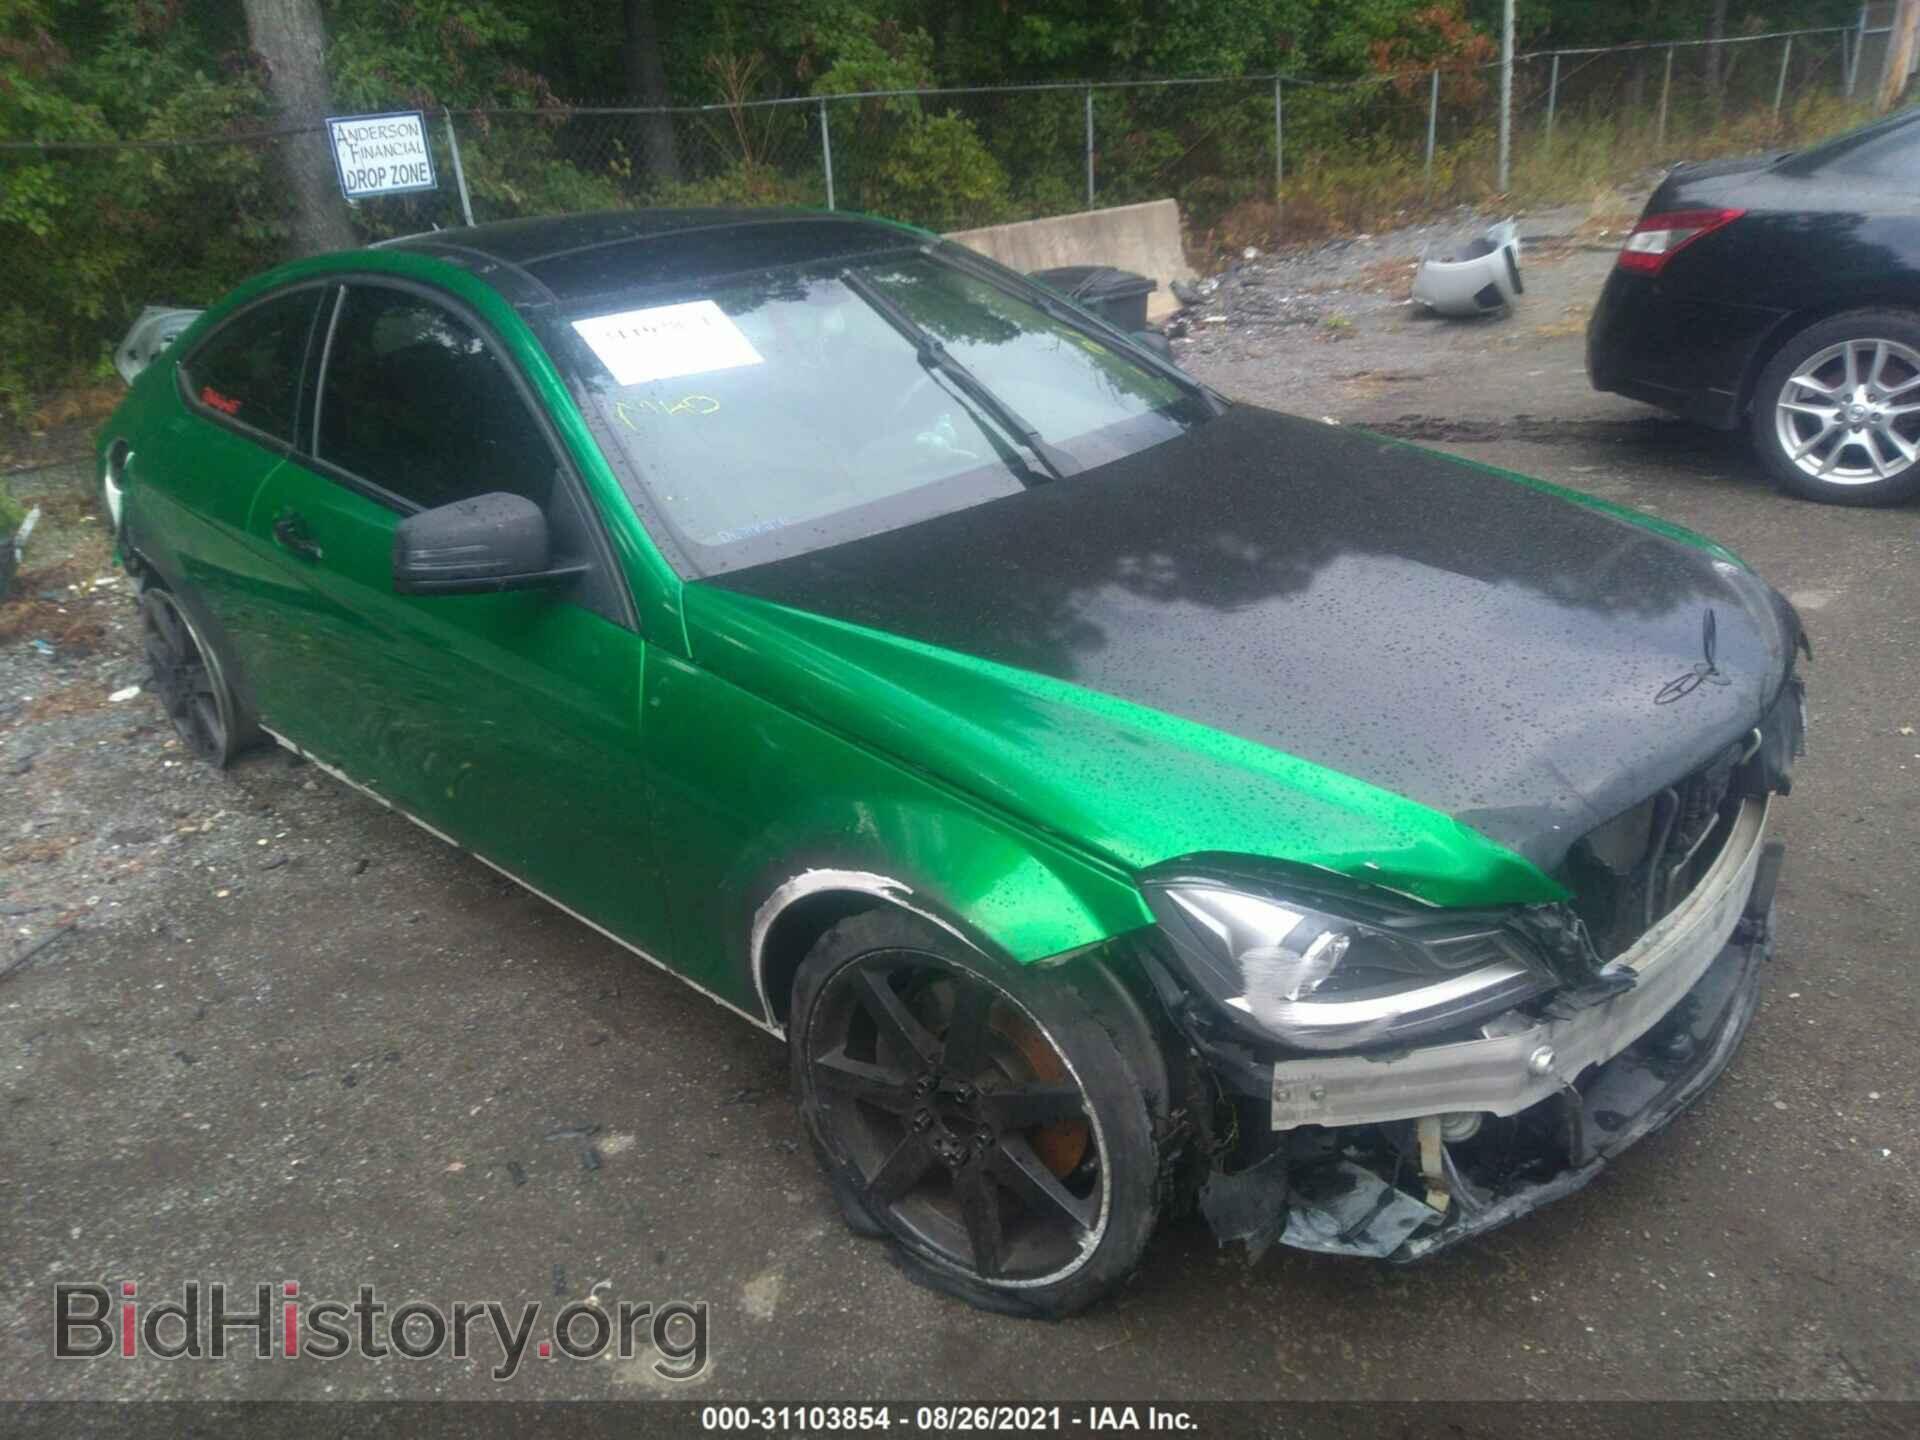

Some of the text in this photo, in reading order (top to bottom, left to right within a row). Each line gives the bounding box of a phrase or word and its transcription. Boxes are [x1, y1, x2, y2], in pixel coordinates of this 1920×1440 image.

[336, 122, 420, 146] ANDERSON
[349, 140, 425, 164] FINANCIAL
[346, 161, 429, 191] DROP ZONE
